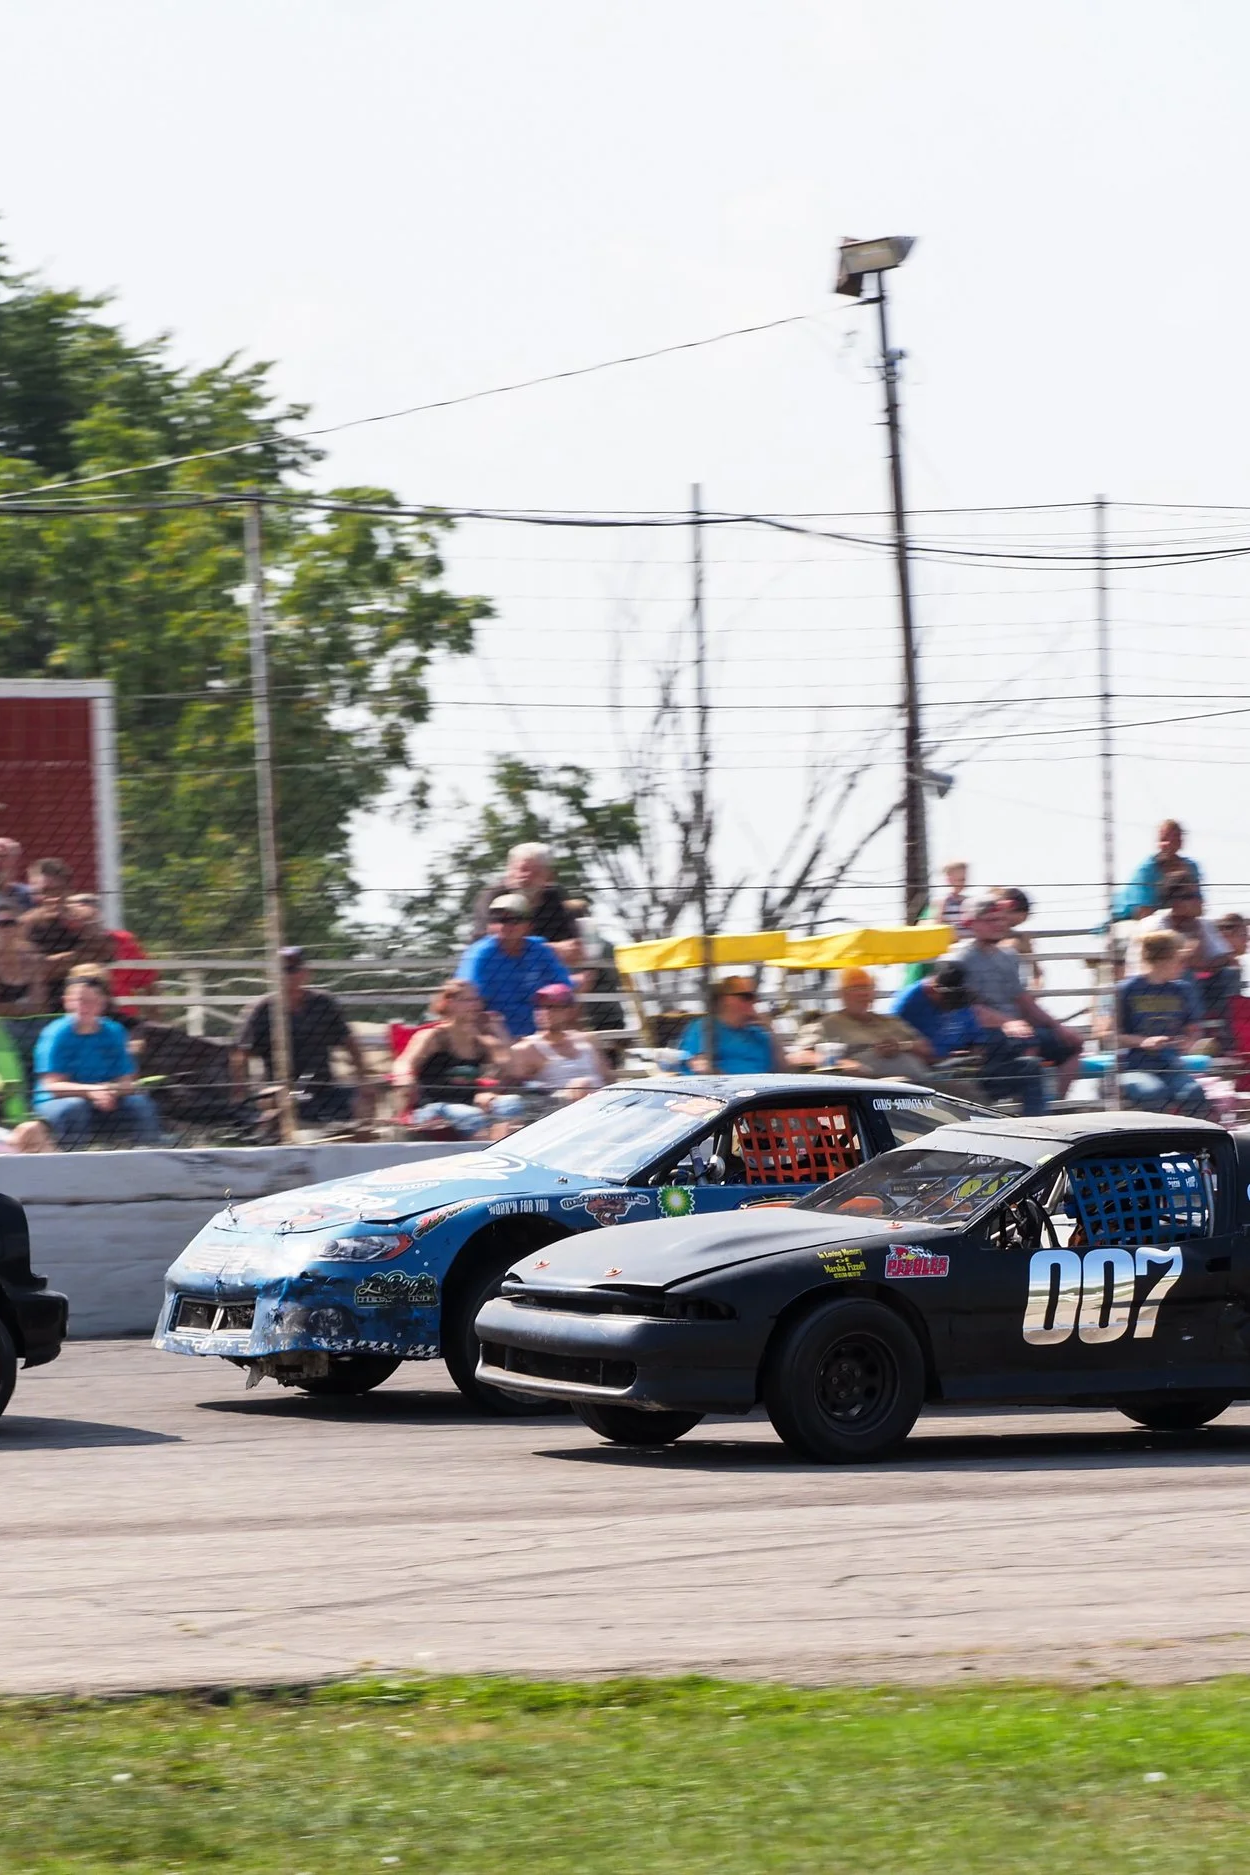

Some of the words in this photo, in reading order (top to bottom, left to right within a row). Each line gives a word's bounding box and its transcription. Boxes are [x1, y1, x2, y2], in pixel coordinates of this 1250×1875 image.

[519, 1199, 534, 1213] FOR
[534, 1198, 549, 1213] YOU
[1022, 1246, 1184, 1345] 007
